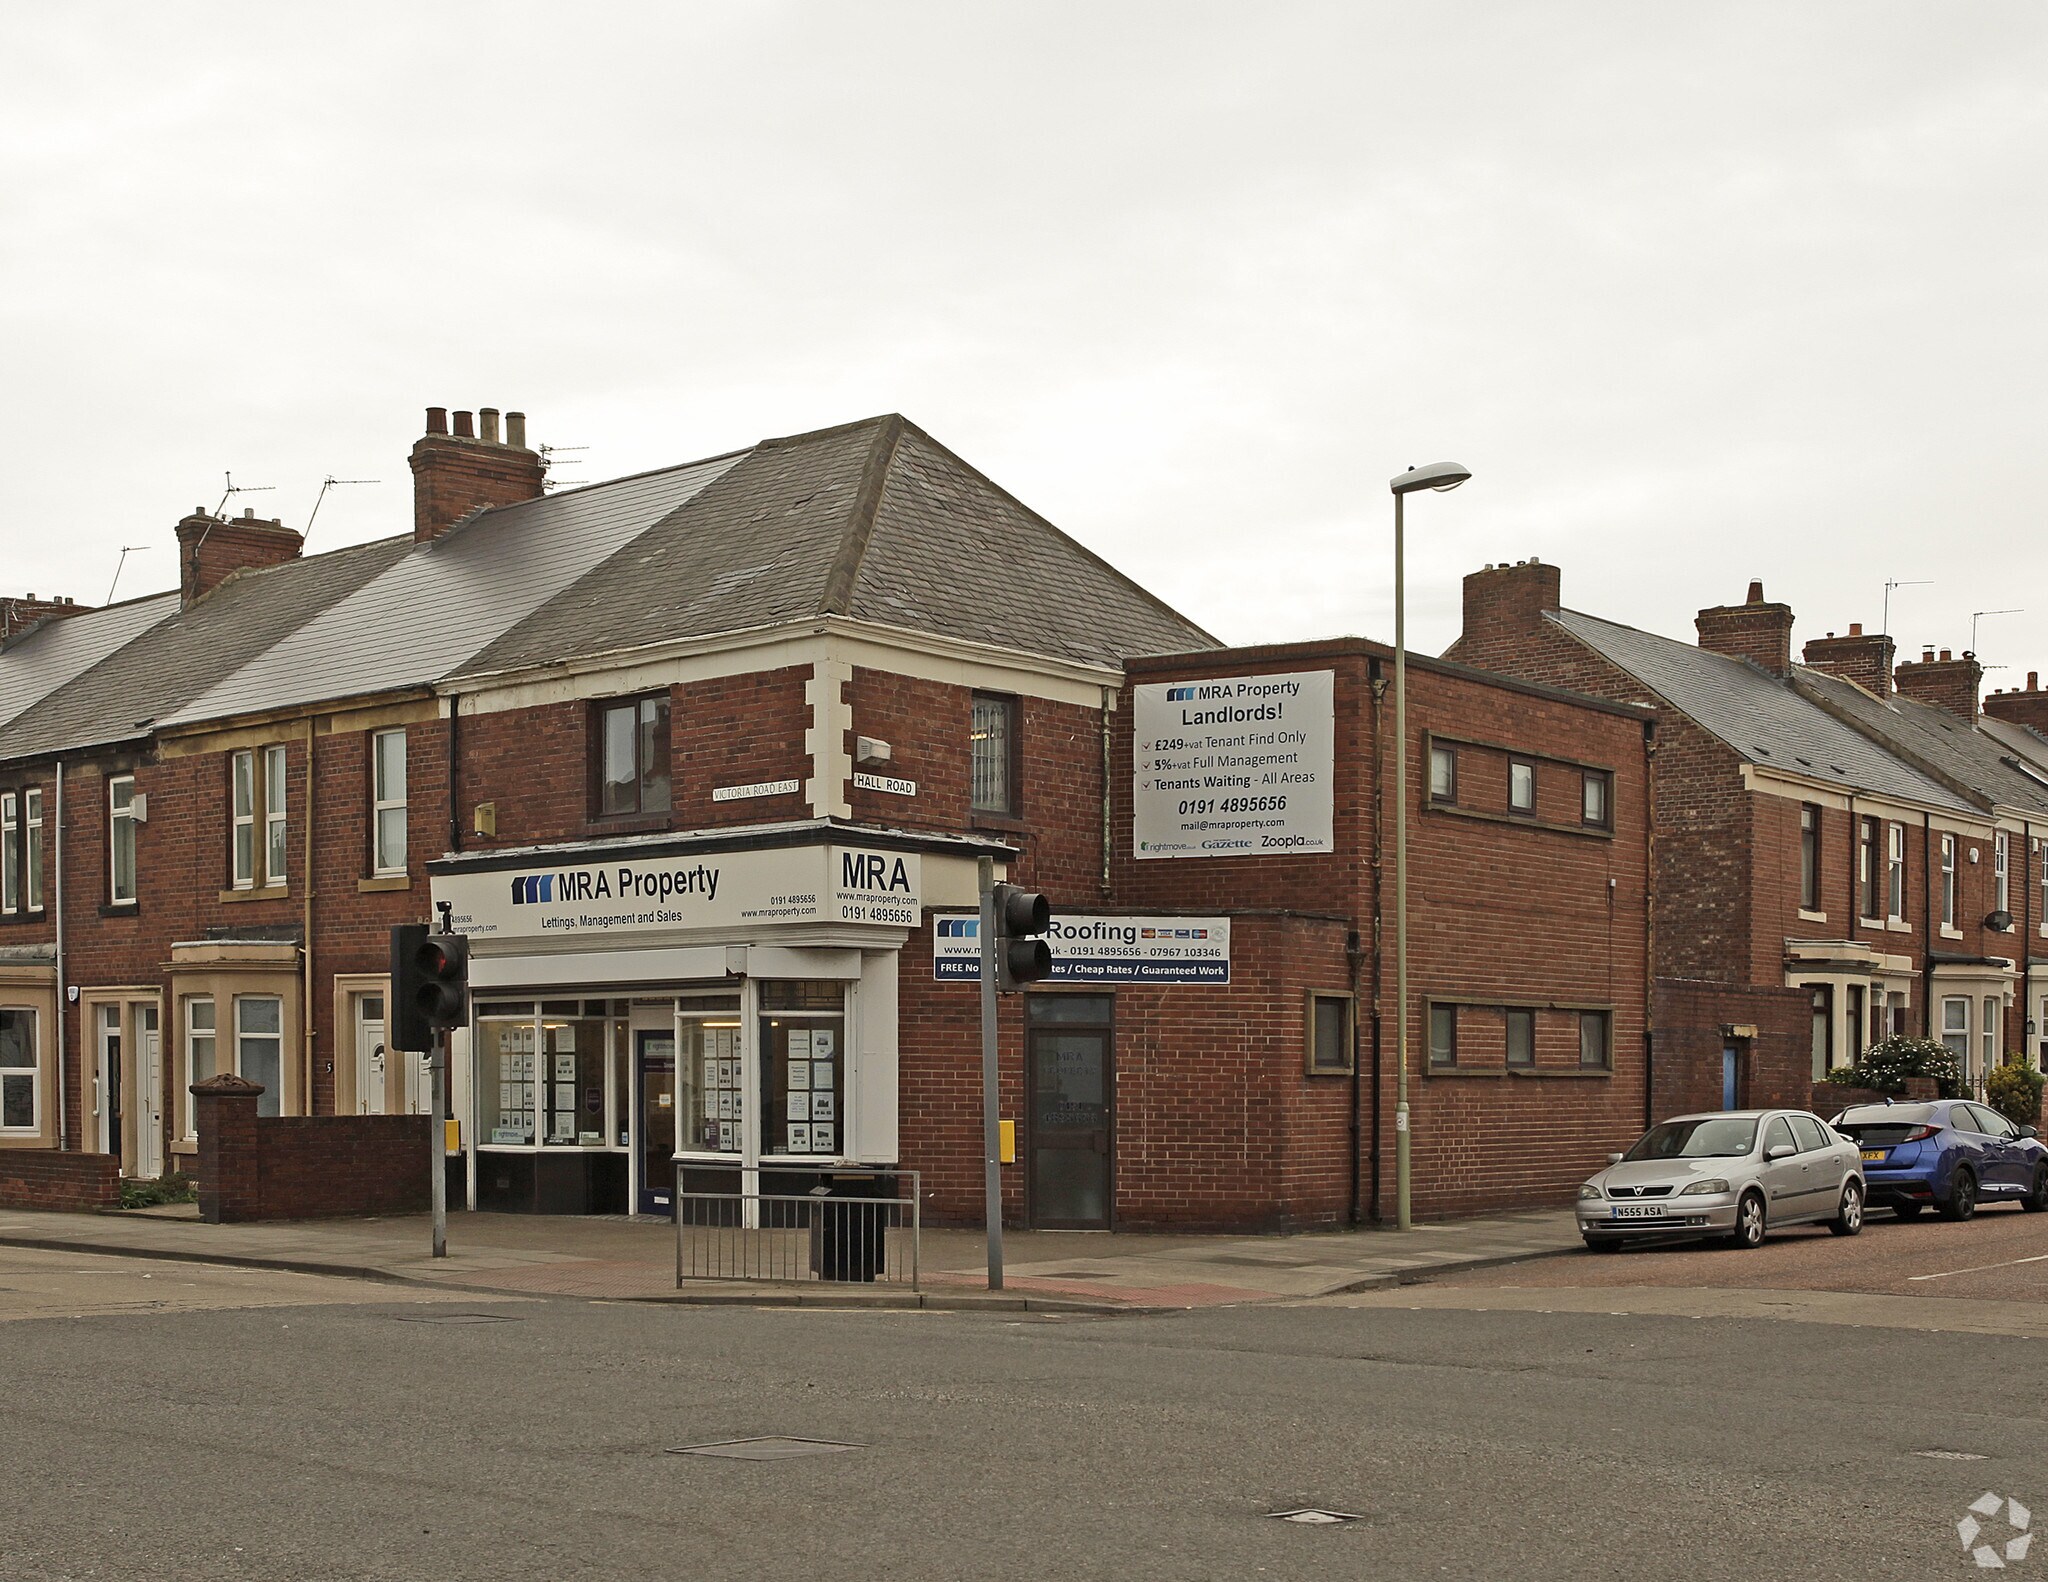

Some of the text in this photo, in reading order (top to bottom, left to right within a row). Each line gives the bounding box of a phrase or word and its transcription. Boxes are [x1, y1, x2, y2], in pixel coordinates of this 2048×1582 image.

[1198, 681, 1300, 700] MRA Property
[1182, 702, 1283, 726] Landlords!
[1205, 734, 1245, 747] Tenant
[1249, 732, 1274, 745] Find
[1278, 730, 1307, 745] Only
[1193, 755, 1214, 769] Full
[1217, 752, 1298, 770] Management
[858, 774, 912, 794] HALL ROAD
[1154, 777, 1200, 791] Tenants
[1204, 774, 1251, 790] Waiting
[1262, 772, 1277, 785] All
[1281, 771, 1315, 785] Areas
[714, 781, 798, 800] VICTORIA ROAD EAST
[1179, 796, 1287, 815] 0191 4895656
[1181, 818, 1285, 832] mail@mraproperty.com
[1201, 840, 1252, 849] Gazette
[843, 852, 911, 893] MRA
[558, 863, 720, 903] MRA Property
[770, 894, 816, 905] 0191 4895656
[836, 891, 918, 906] www.mraproperty.com
[541, 909, 682, 930] Lettings, Management and Sales
[741, 906, 816, 918] www.mraproperty.com
[842, 905, 912, 923] 0191 4895656
[1047, 922, 1136, 945] Roofing
[1070, 946, 1095, 956] 0191
[1098, 946, 1141, 956] 4895656
[1150, 947, 1181, 957] 07967
[1184, 948, 1221, 957] 103346
[940, 963, 963, 972] FREE
[965, 963, 979, 972] No
[1074, 964, 1104, 976] Cheap
[1106, 965, 1132, 974] Rates
[1141, 965, 1197, 975] Guaranteed
[1199, 966, 1224, 975] Work
[326, 1062, 332, 1073] 5
[1617, 1207, 1662, 1217] N555 ASA
